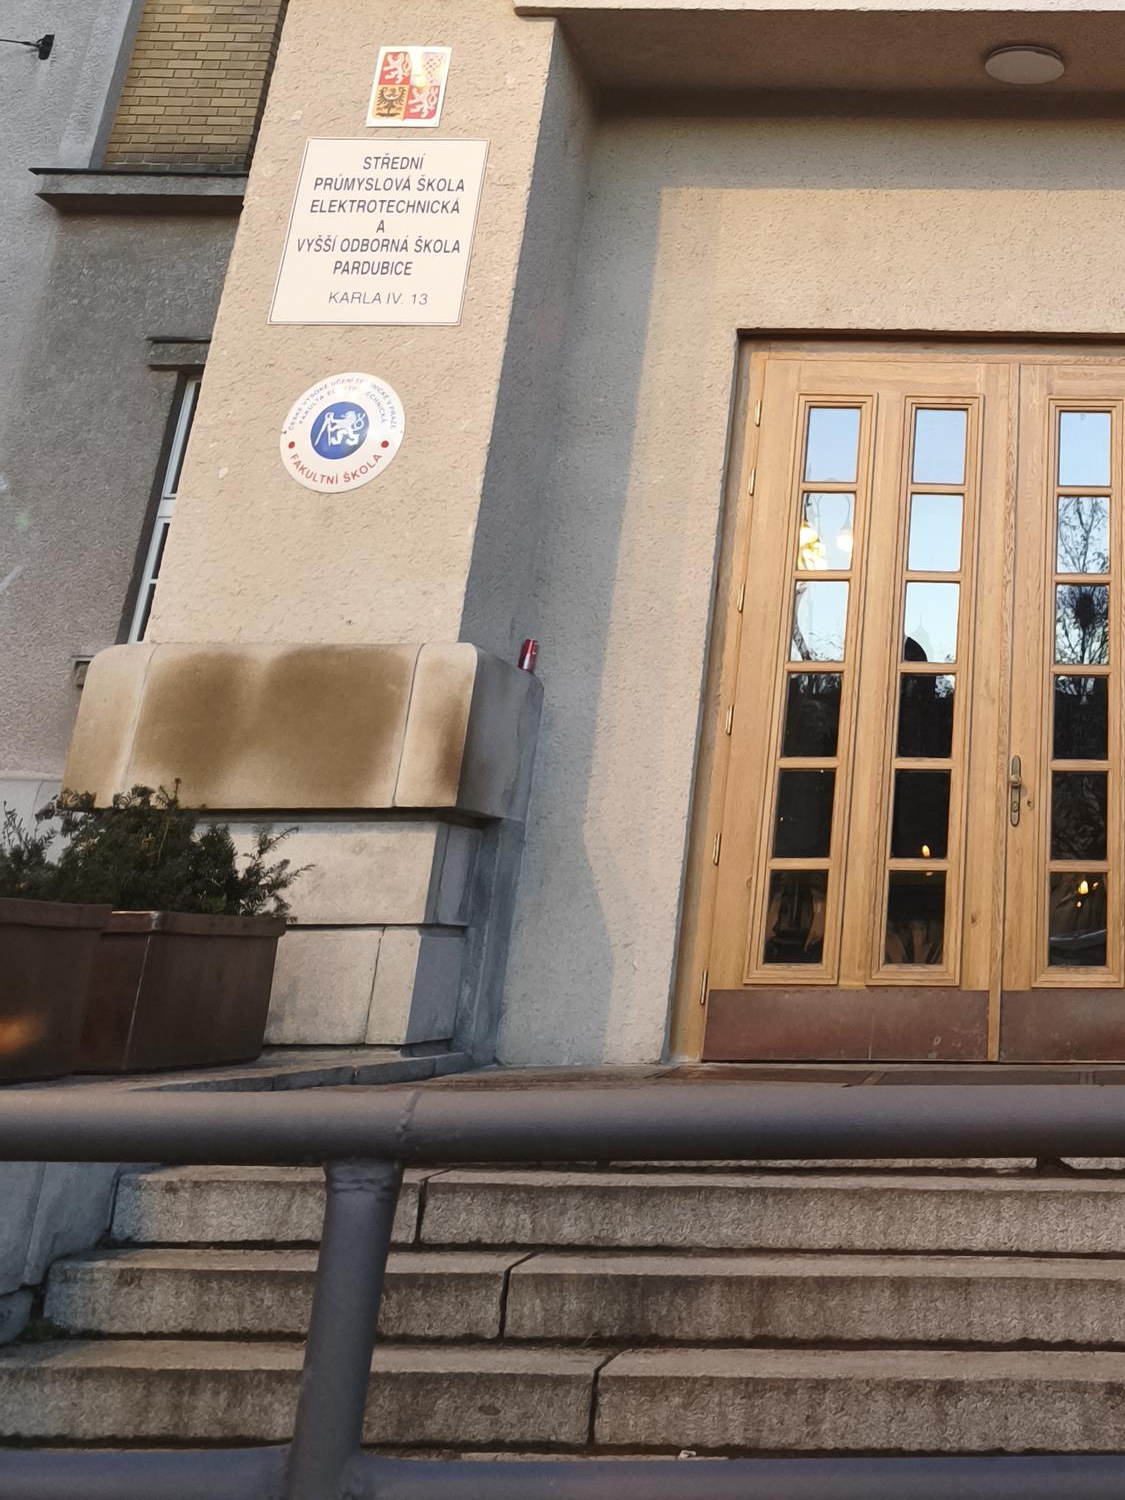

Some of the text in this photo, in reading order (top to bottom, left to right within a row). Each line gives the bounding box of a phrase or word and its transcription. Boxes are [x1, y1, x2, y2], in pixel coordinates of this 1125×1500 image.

[363, 153, 426, 169] STŘEDNÍ
[314, 174, 464, 192] PRŮMYSLOVÁ ŠKOLA
[310, 198, 460, 213] ELEKTROTECHNICKÁ
[376, 220, 385, 233] A
[297, 235, 460, 253] VYŠŠÍ ODBORNÁ ŠKOLA
[333, 261, 413, 275] PARDUBICE
[329, 292, 428, 305] KARLA IV. 13
[290, 453, 382, 484] FAKULTNÍ ŠKOLA
